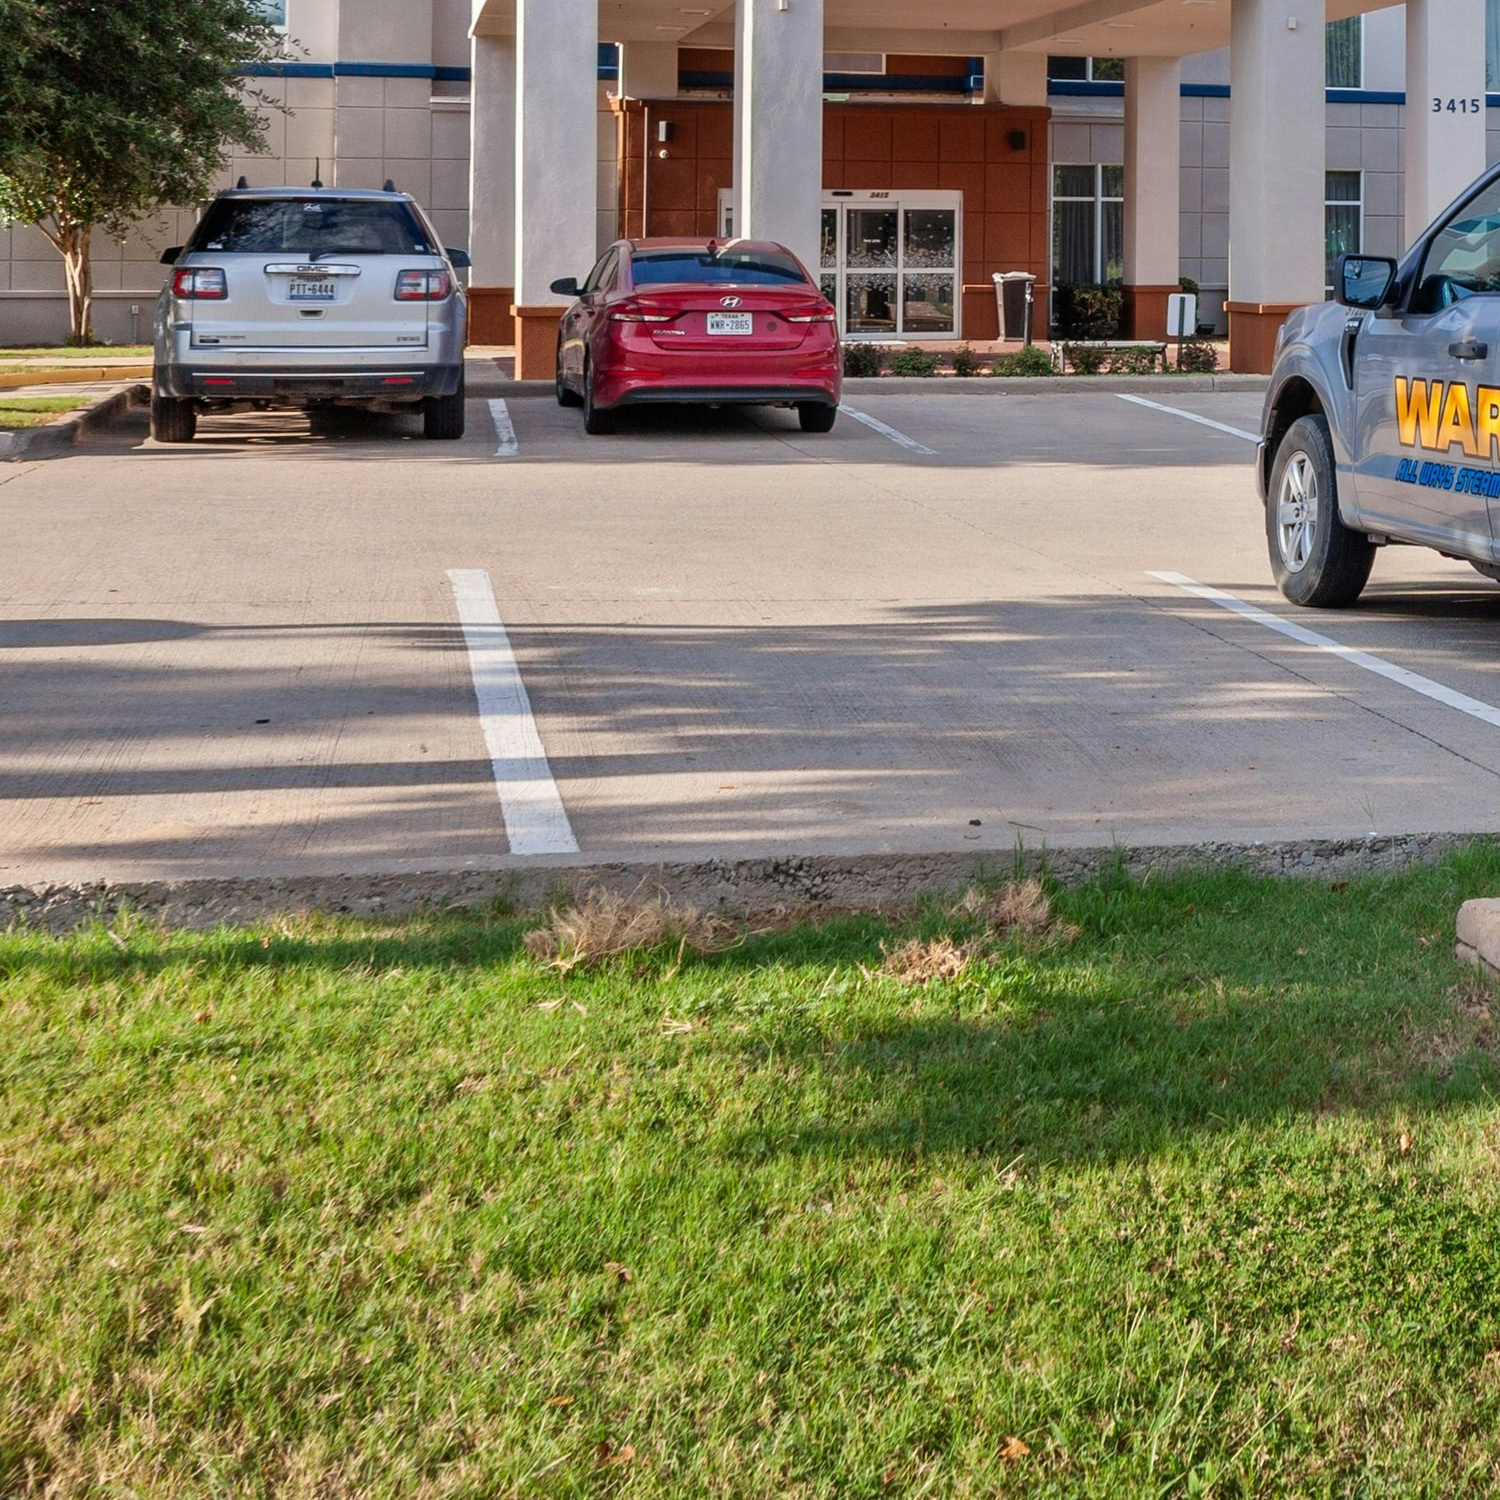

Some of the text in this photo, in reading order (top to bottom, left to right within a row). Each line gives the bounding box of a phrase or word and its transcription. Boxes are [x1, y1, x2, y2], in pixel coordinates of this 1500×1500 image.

[1432, 97, 1480, 113] 3415
[869, 191, 890, 199] 3415
[296, 265, 329, 273] GMC
[289, 283, 335, 295] PTT-6444
[710, 319, 750, 330] WNR-2865
[1395, 458, 1419, 484] ALL
[1419, 461, 1456, 490] WAYS
